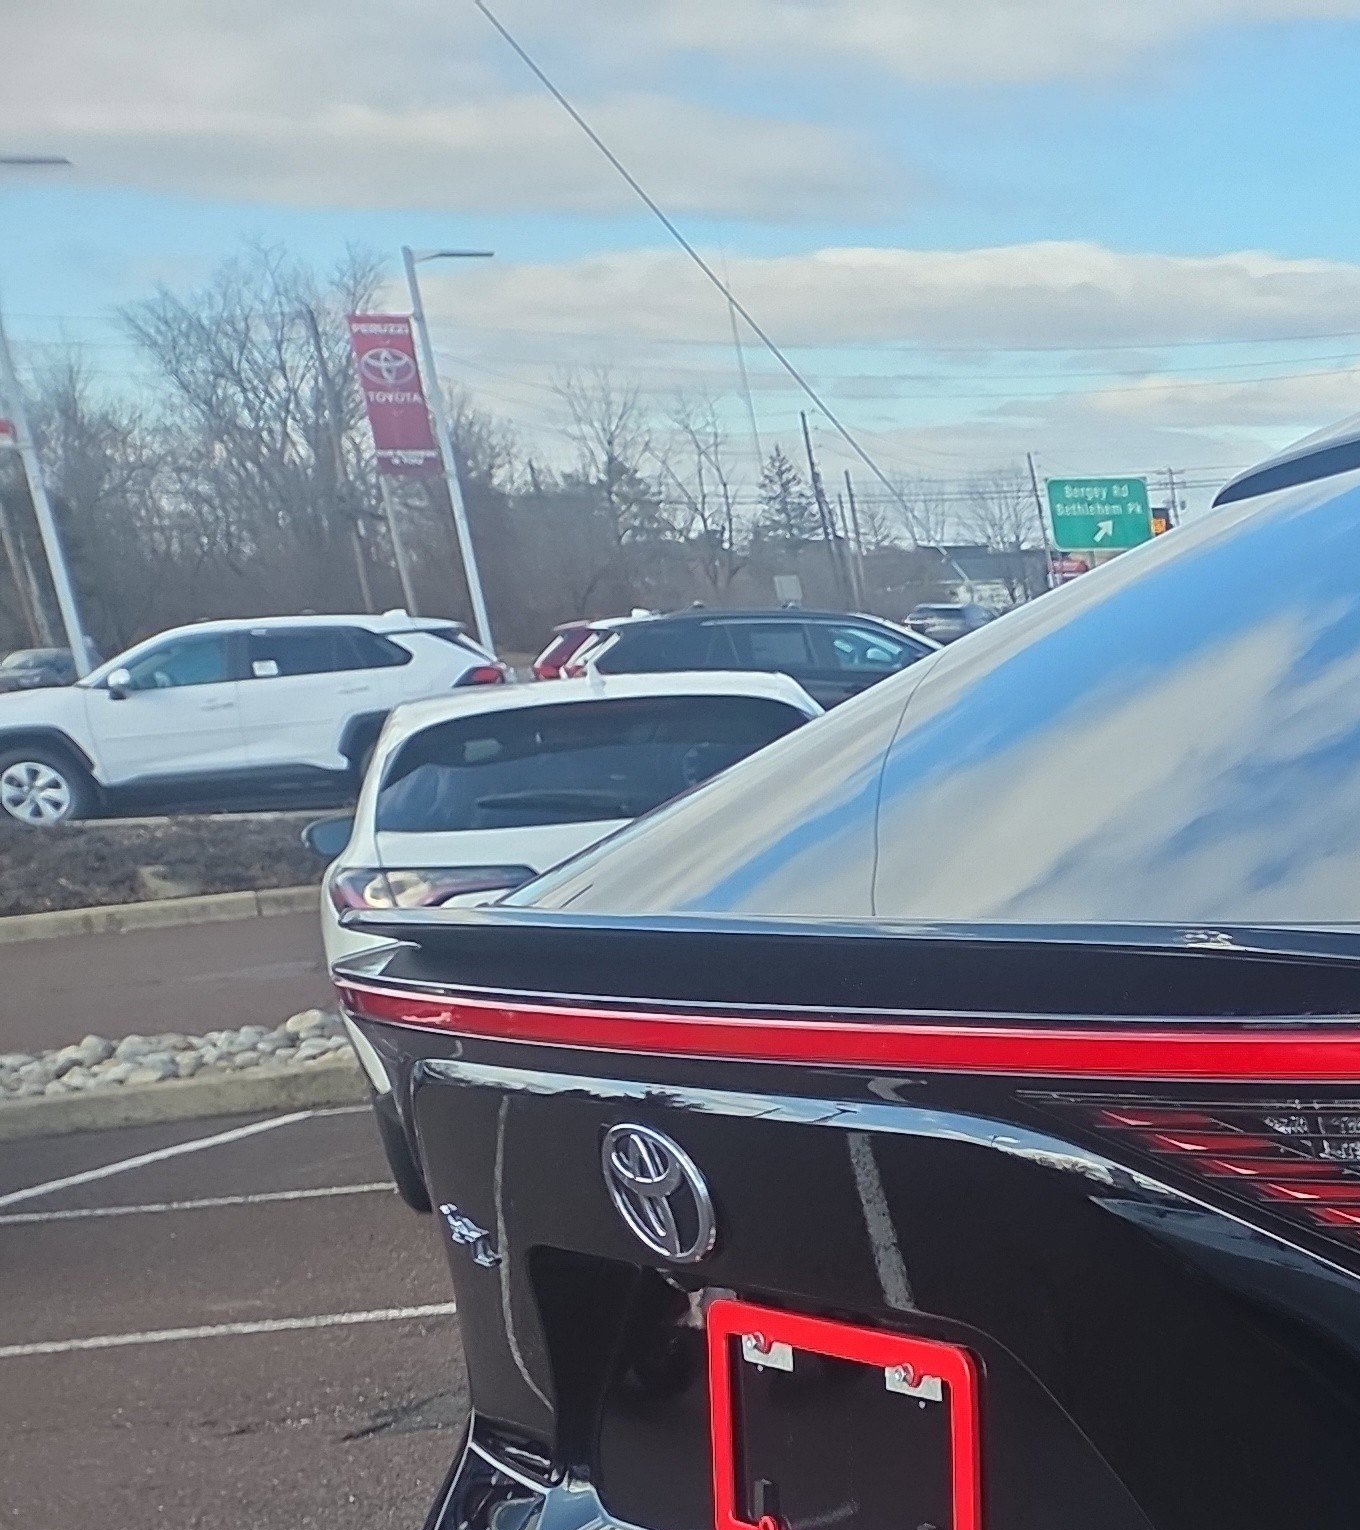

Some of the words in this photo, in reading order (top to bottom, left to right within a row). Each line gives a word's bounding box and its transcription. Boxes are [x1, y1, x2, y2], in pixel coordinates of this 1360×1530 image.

[368, 391, 423, 403] TOYOTA
[1064, 484, 1108, 500] Bergey
[1112, 484, 1129, 498] Rd
[1055, 502, 1123, 516] Bethlehem
